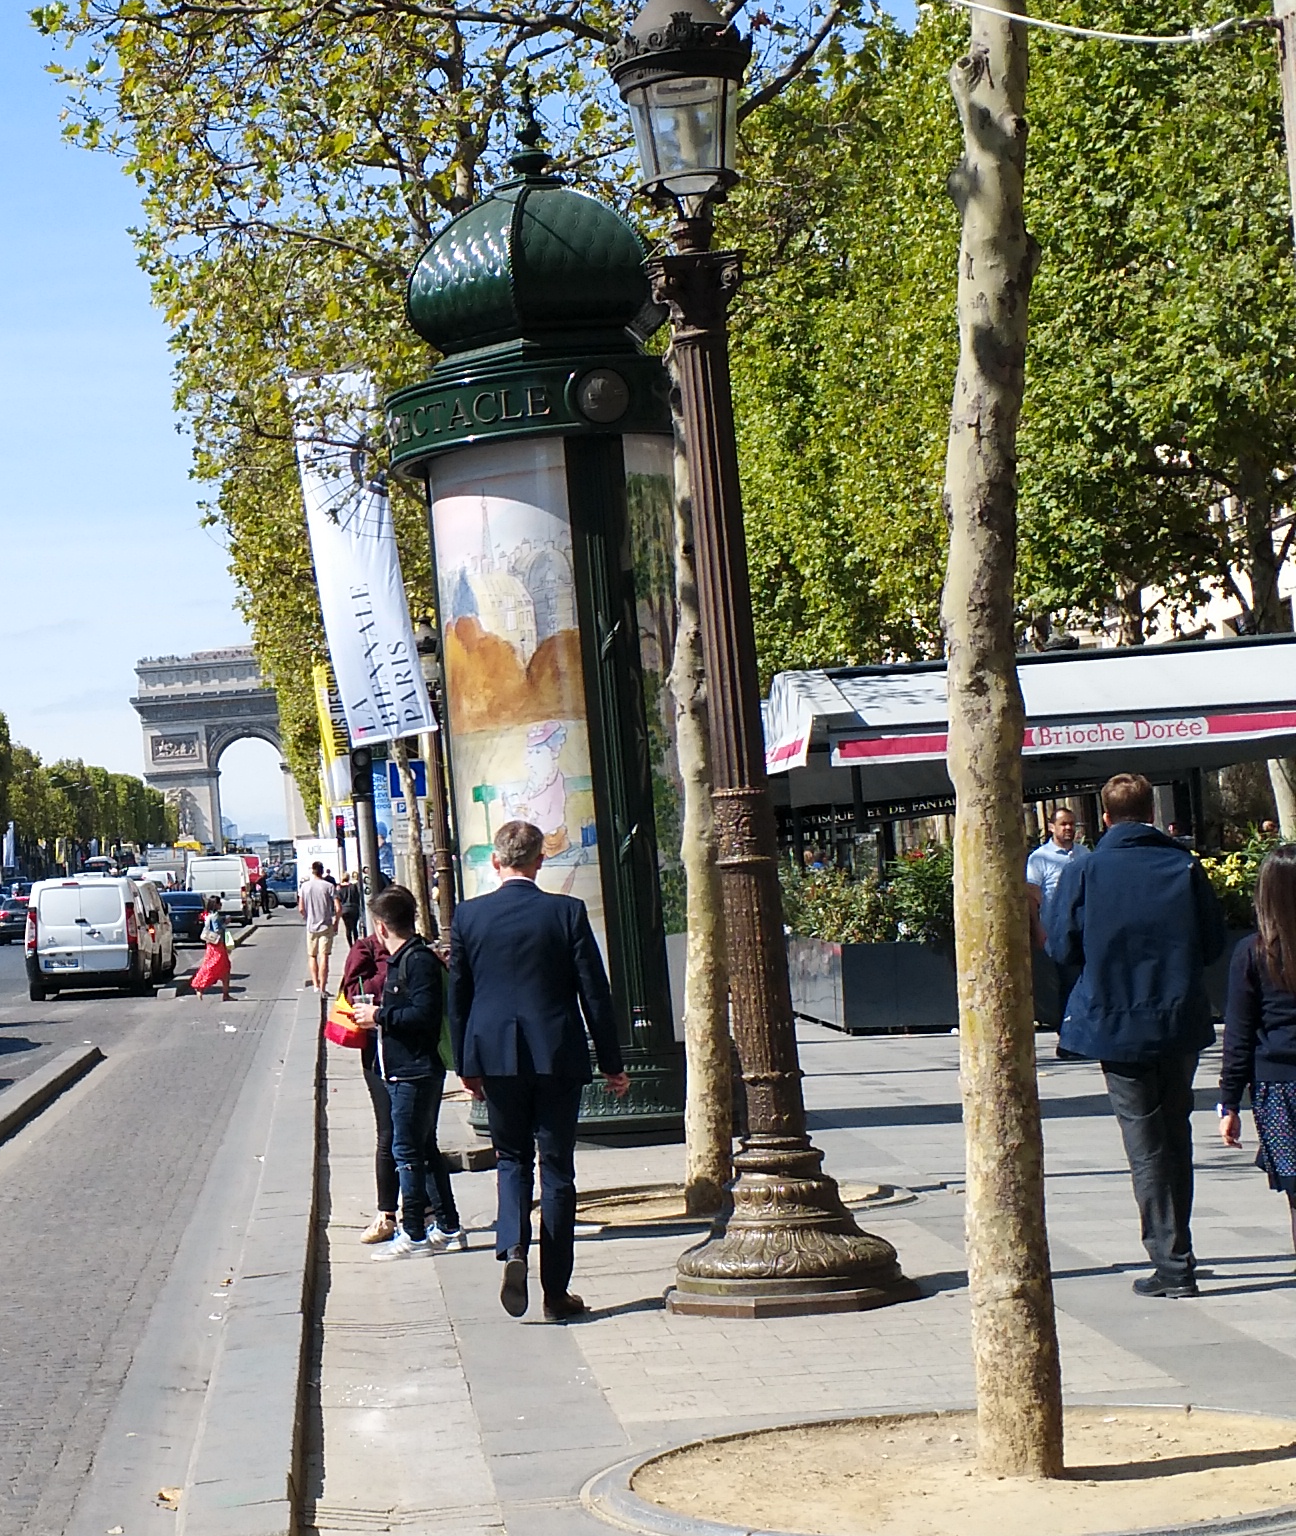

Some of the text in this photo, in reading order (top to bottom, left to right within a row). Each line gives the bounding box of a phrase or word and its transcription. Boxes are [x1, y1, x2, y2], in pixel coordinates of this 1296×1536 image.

[349, 583, 400, 727] BIENNALE
[387, 640, 424, 722] PARIS
[351, 697, 377, 733] LA
[1038, 718, 1203, 747] Brioche Dorée
[331, 718, 350, 757] PARIS
[866, 808, 881, 818] ET
[889, 805, 907, 815] DE
